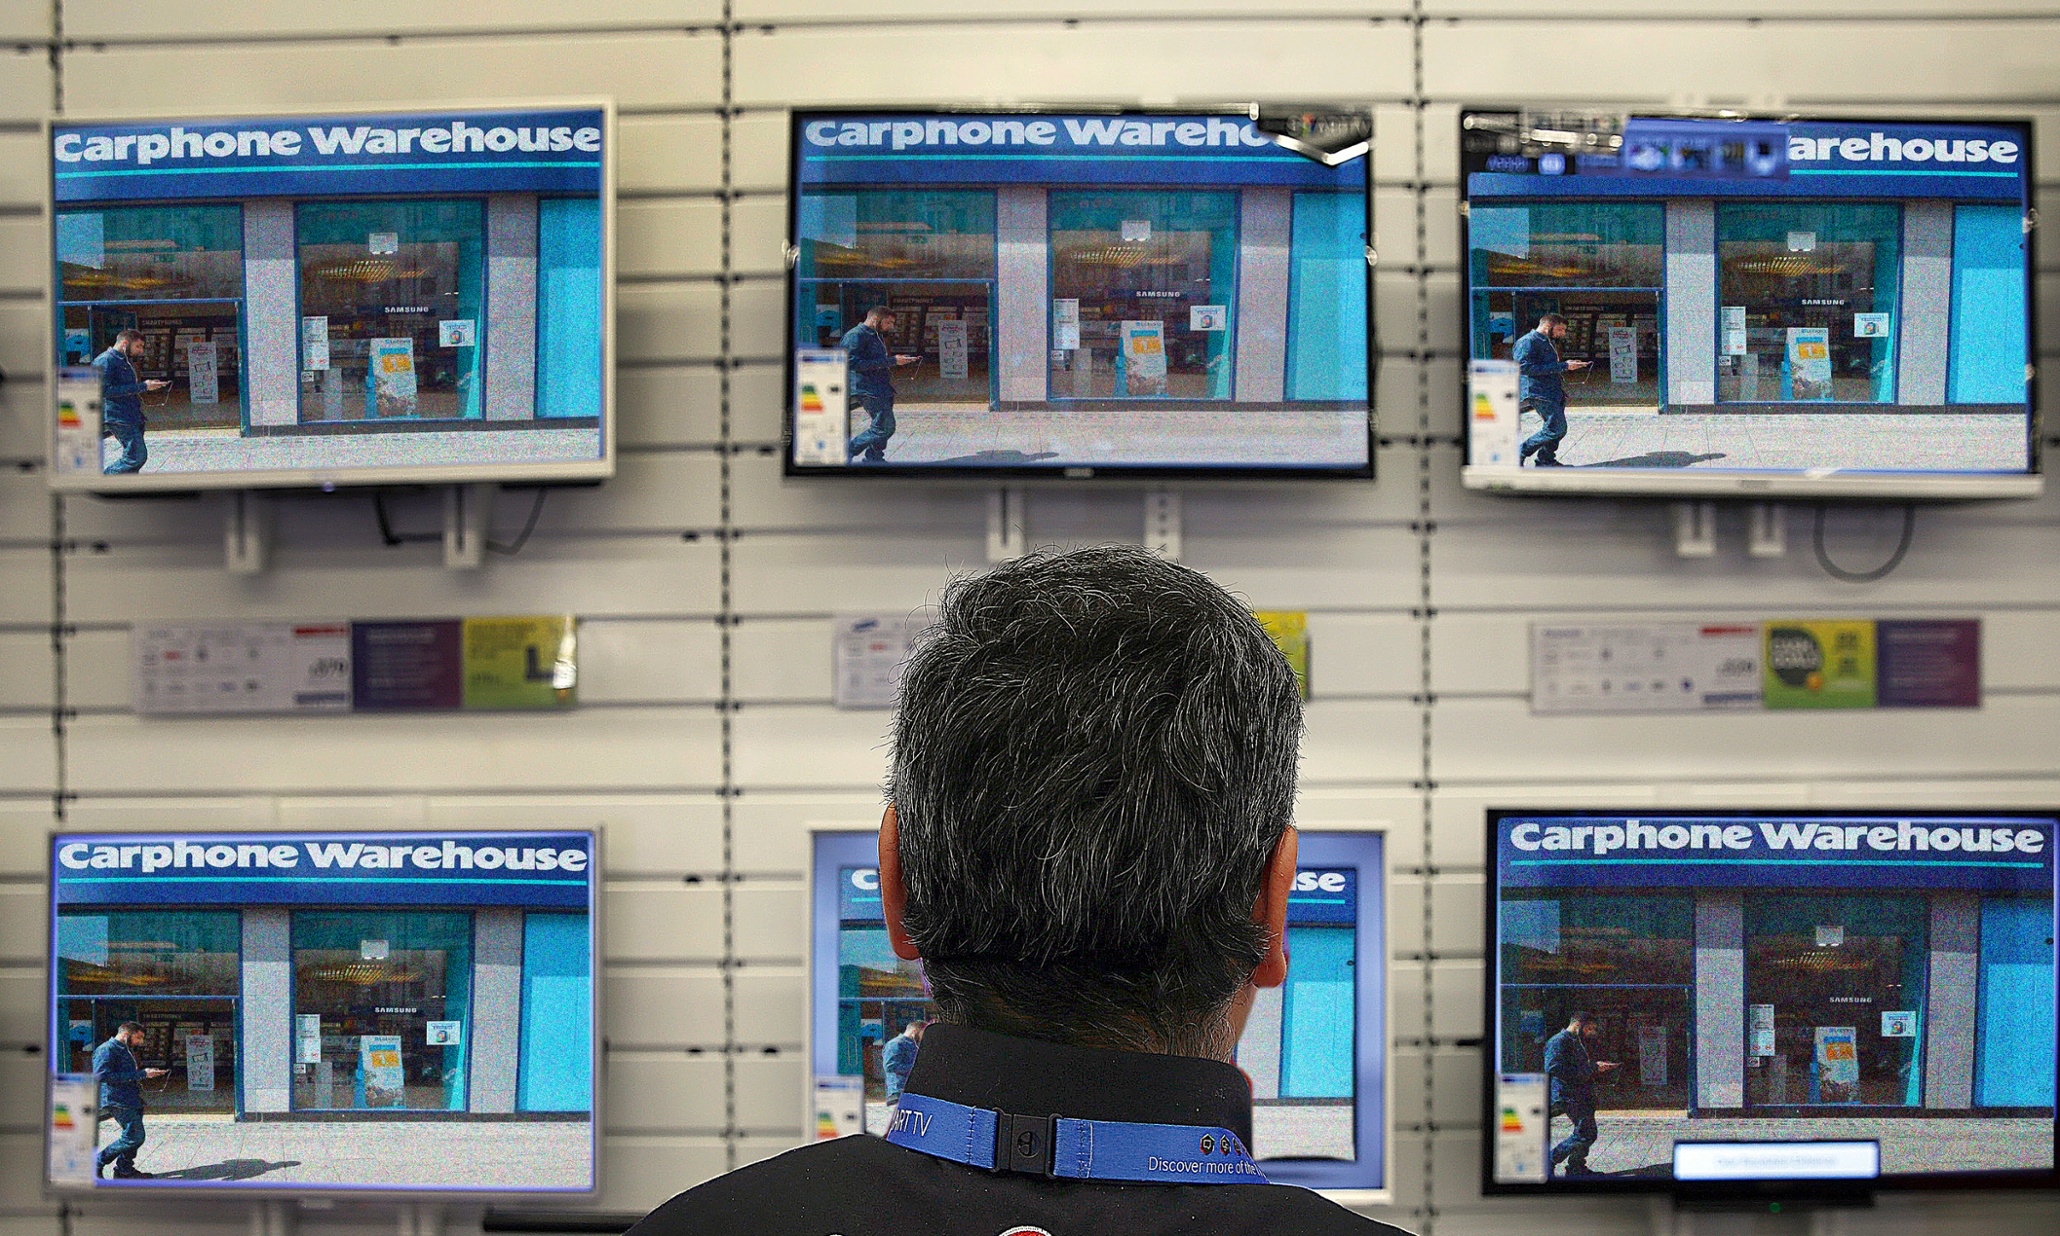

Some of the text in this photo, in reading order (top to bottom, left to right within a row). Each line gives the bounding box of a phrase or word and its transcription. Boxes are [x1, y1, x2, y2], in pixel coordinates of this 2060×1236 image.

[55, 121, 600, 164] Carphone Warehouse
[806, 119, 1056, 149] Carphone
[1064, 119, 1272, 147] Wareho
[1788, 132, 2018, 163] arehouse
[1511, 820, 2044, 855] Carphone Warehouse
[59, 840, 588, 873] Carphone Warehouse
[913, 1110, 933, 1138] TV
[1149, 1156, 1204, 1173] Discover
[1206, 1162, 1234, 1174] more
[1235, 1160, 1244, 1174] of
